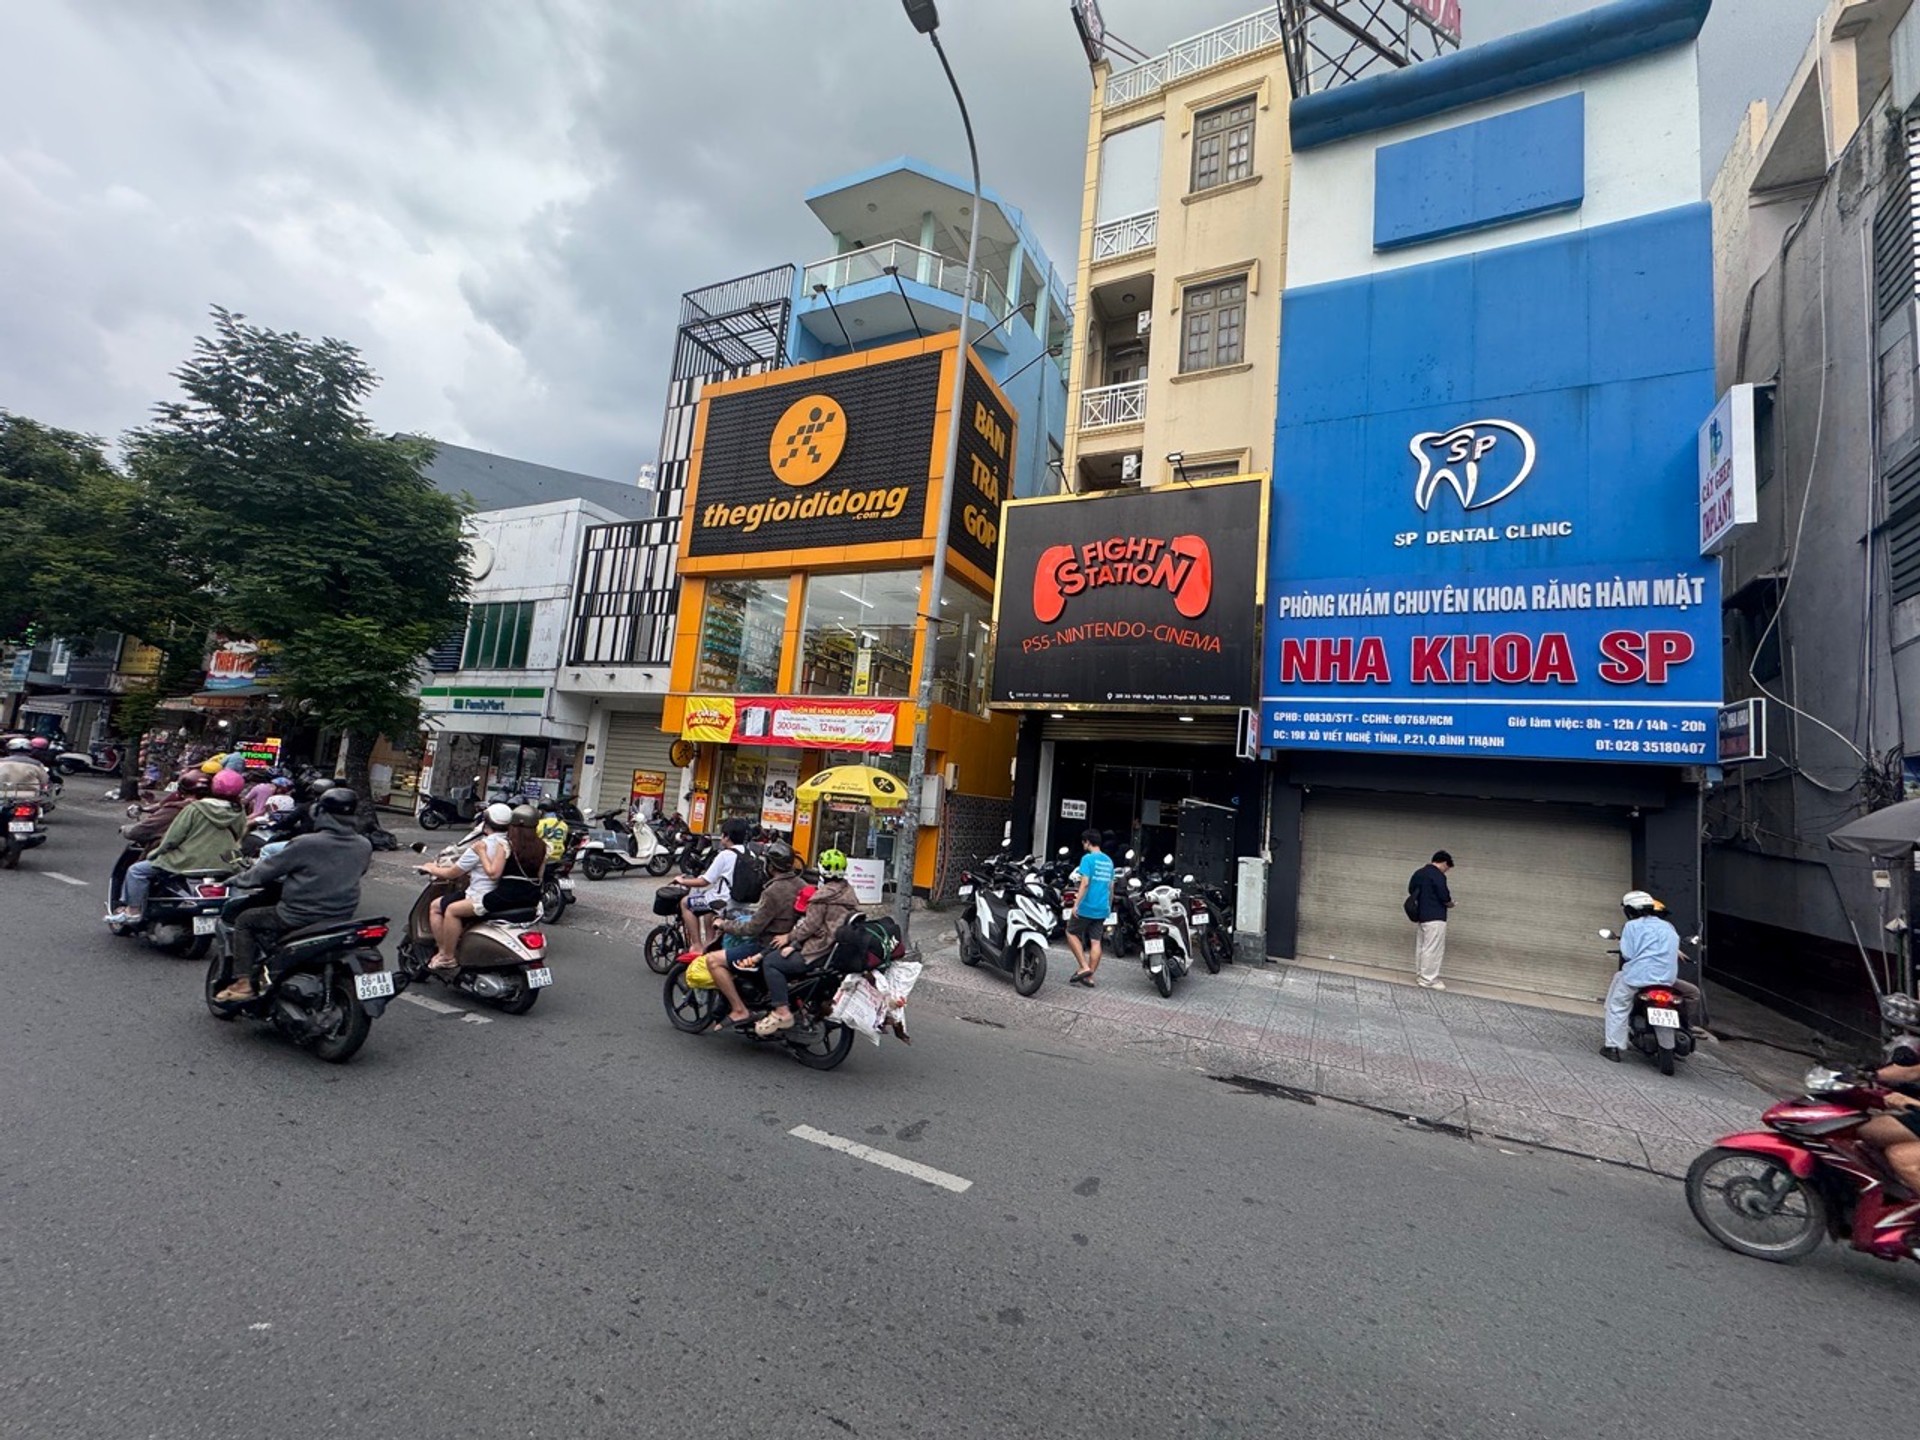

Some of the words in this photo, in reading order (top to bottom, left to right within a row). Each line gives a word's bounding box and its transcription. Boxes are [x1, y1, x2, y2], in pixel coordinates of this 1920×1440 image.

[974, 400, 1005, 459] BÁN
[1446, 435, 1497, 462] SP
[971, 453, 999, 507] TRẢ
[702, 487, 909, 532] thegioididong
[963, 504, 997, 549] GÓP
[1394, 532, 1418, 547] SP
[1426, 527, 1499, 545] DENTAL
[1505, 521, 1572, 539] CLINIC
[1081, 537, 1165, 566] FIGHT
[1057, 553, 1189, 594] STATION
[1279, 591, 1335, 618] PHÒNG
[1337, 588, 1391, 616] KHÁM
[1393, 585, 1470, 615] CHUYÊN
[1472, 584, 1528, 612] KHOA
[1531, 579, 1592, 610] RĂNG
[1595, 576, 1649, 607] HÀM
[1652, 573, 1706, 610] MẶT
[1022, 621, 1221, 654] PS5-NINTENDO-CINEMA
[1280, 635, 1391, 683] NHA
[1410, 632, 1579, 684] KHOA
[1598, 630, 1695, 684] SP
[465, 699, 505, 711] FamilyMart
[1362, 714, 1392, 724] CCHN:
[820, 723, 828, 731] 12
[1322, 729, 1343, 741] VIẾT
[1345, 731, 1371, 744] NGHỆ
[1468, 735, 1505, 748] THẠNH
[1508, 716, 1527, 728] Giờ
[1530, 717, 1552, 728] làm
[1554, 717, 1584, 730] việc:
[1586, 719, 1601, 729] 8h
[1613, 719, 1634, 730] 12h
[1646, 719, 1668, 731] 14h
[1681, 720, 1706, 732] 20h
[1615, 740, 1639, 751] 028
[1642, 742, 1706, 754] 35180407
